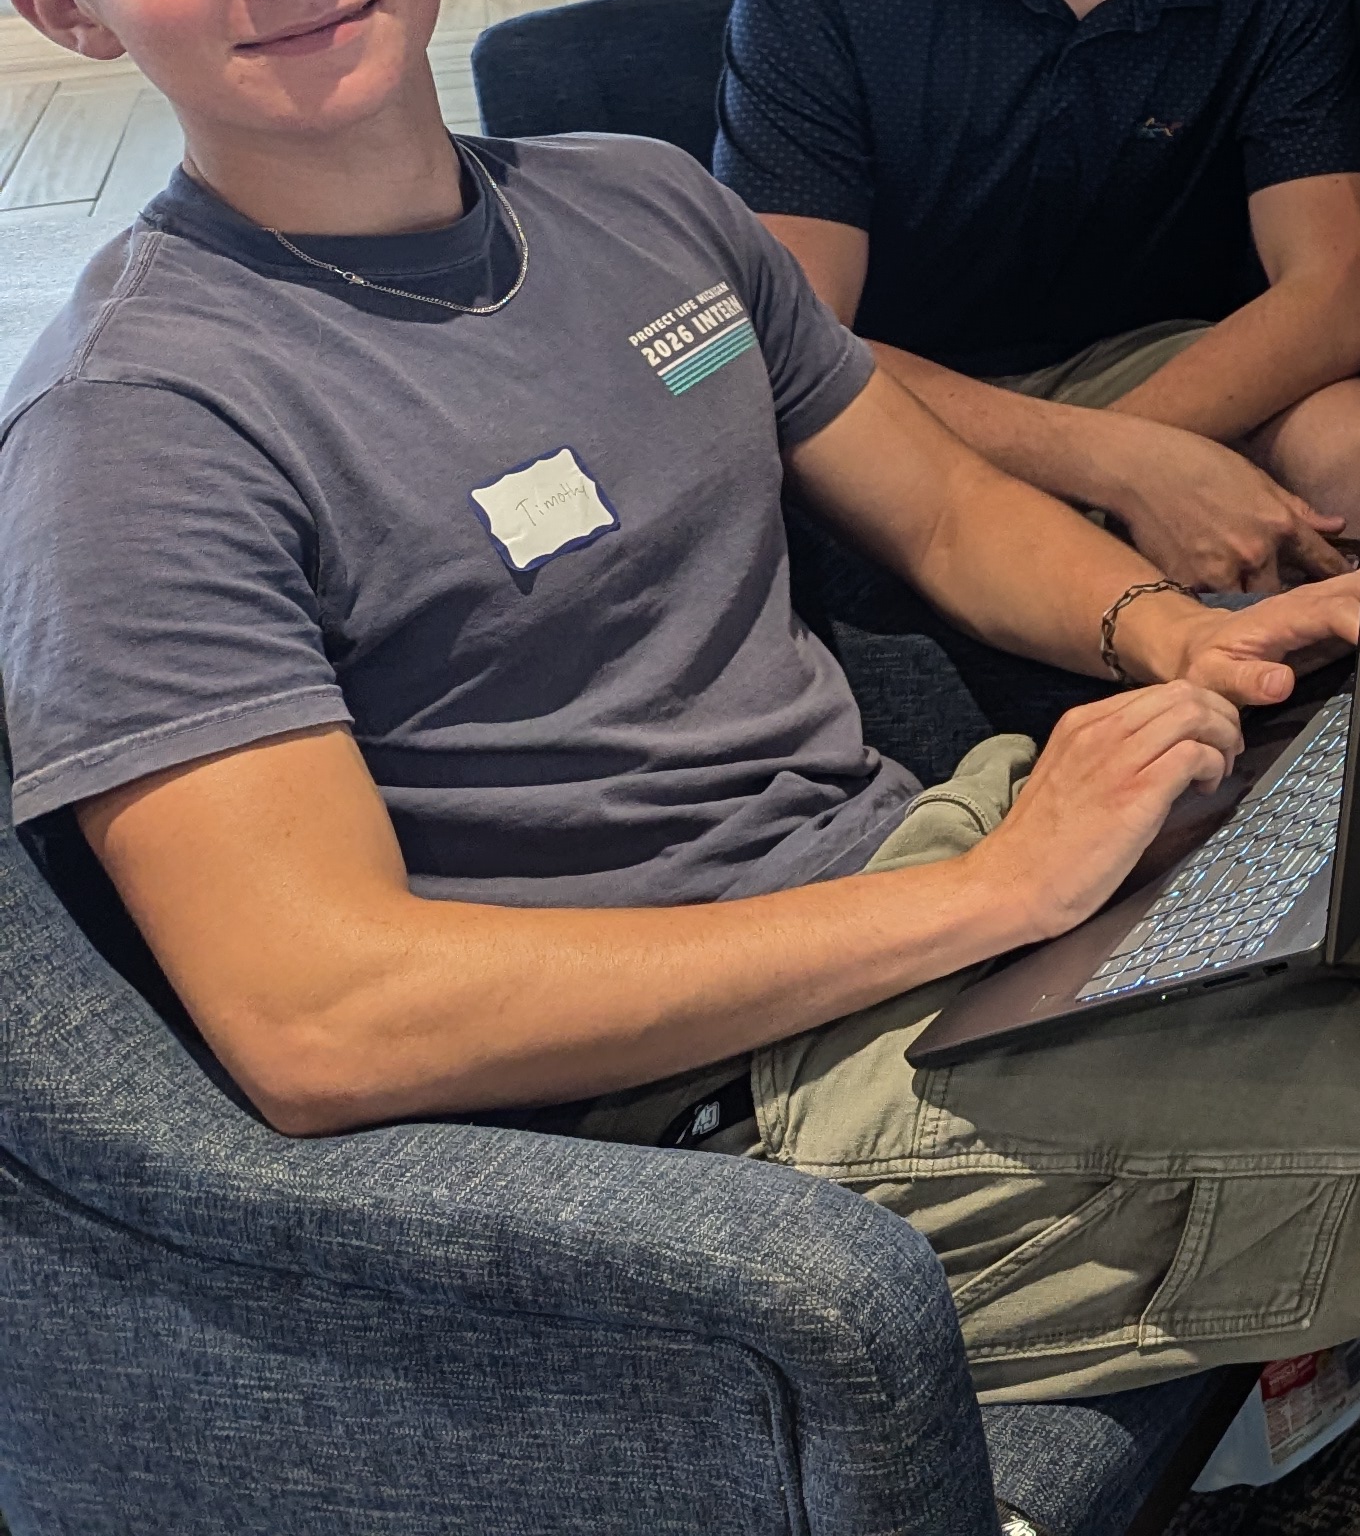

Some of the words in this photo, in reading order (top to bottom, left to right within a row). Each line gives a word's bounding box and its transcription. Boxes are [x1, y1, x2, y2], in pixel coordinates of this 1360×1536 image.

[629, 311, 677, 347] PROTECT
[674, 299, 699, 318] LIFE
[641, 324, 695, 368] 2026
[691, 294, 744, 335] INTERN
[515, 478, 590, 527] Timothy
